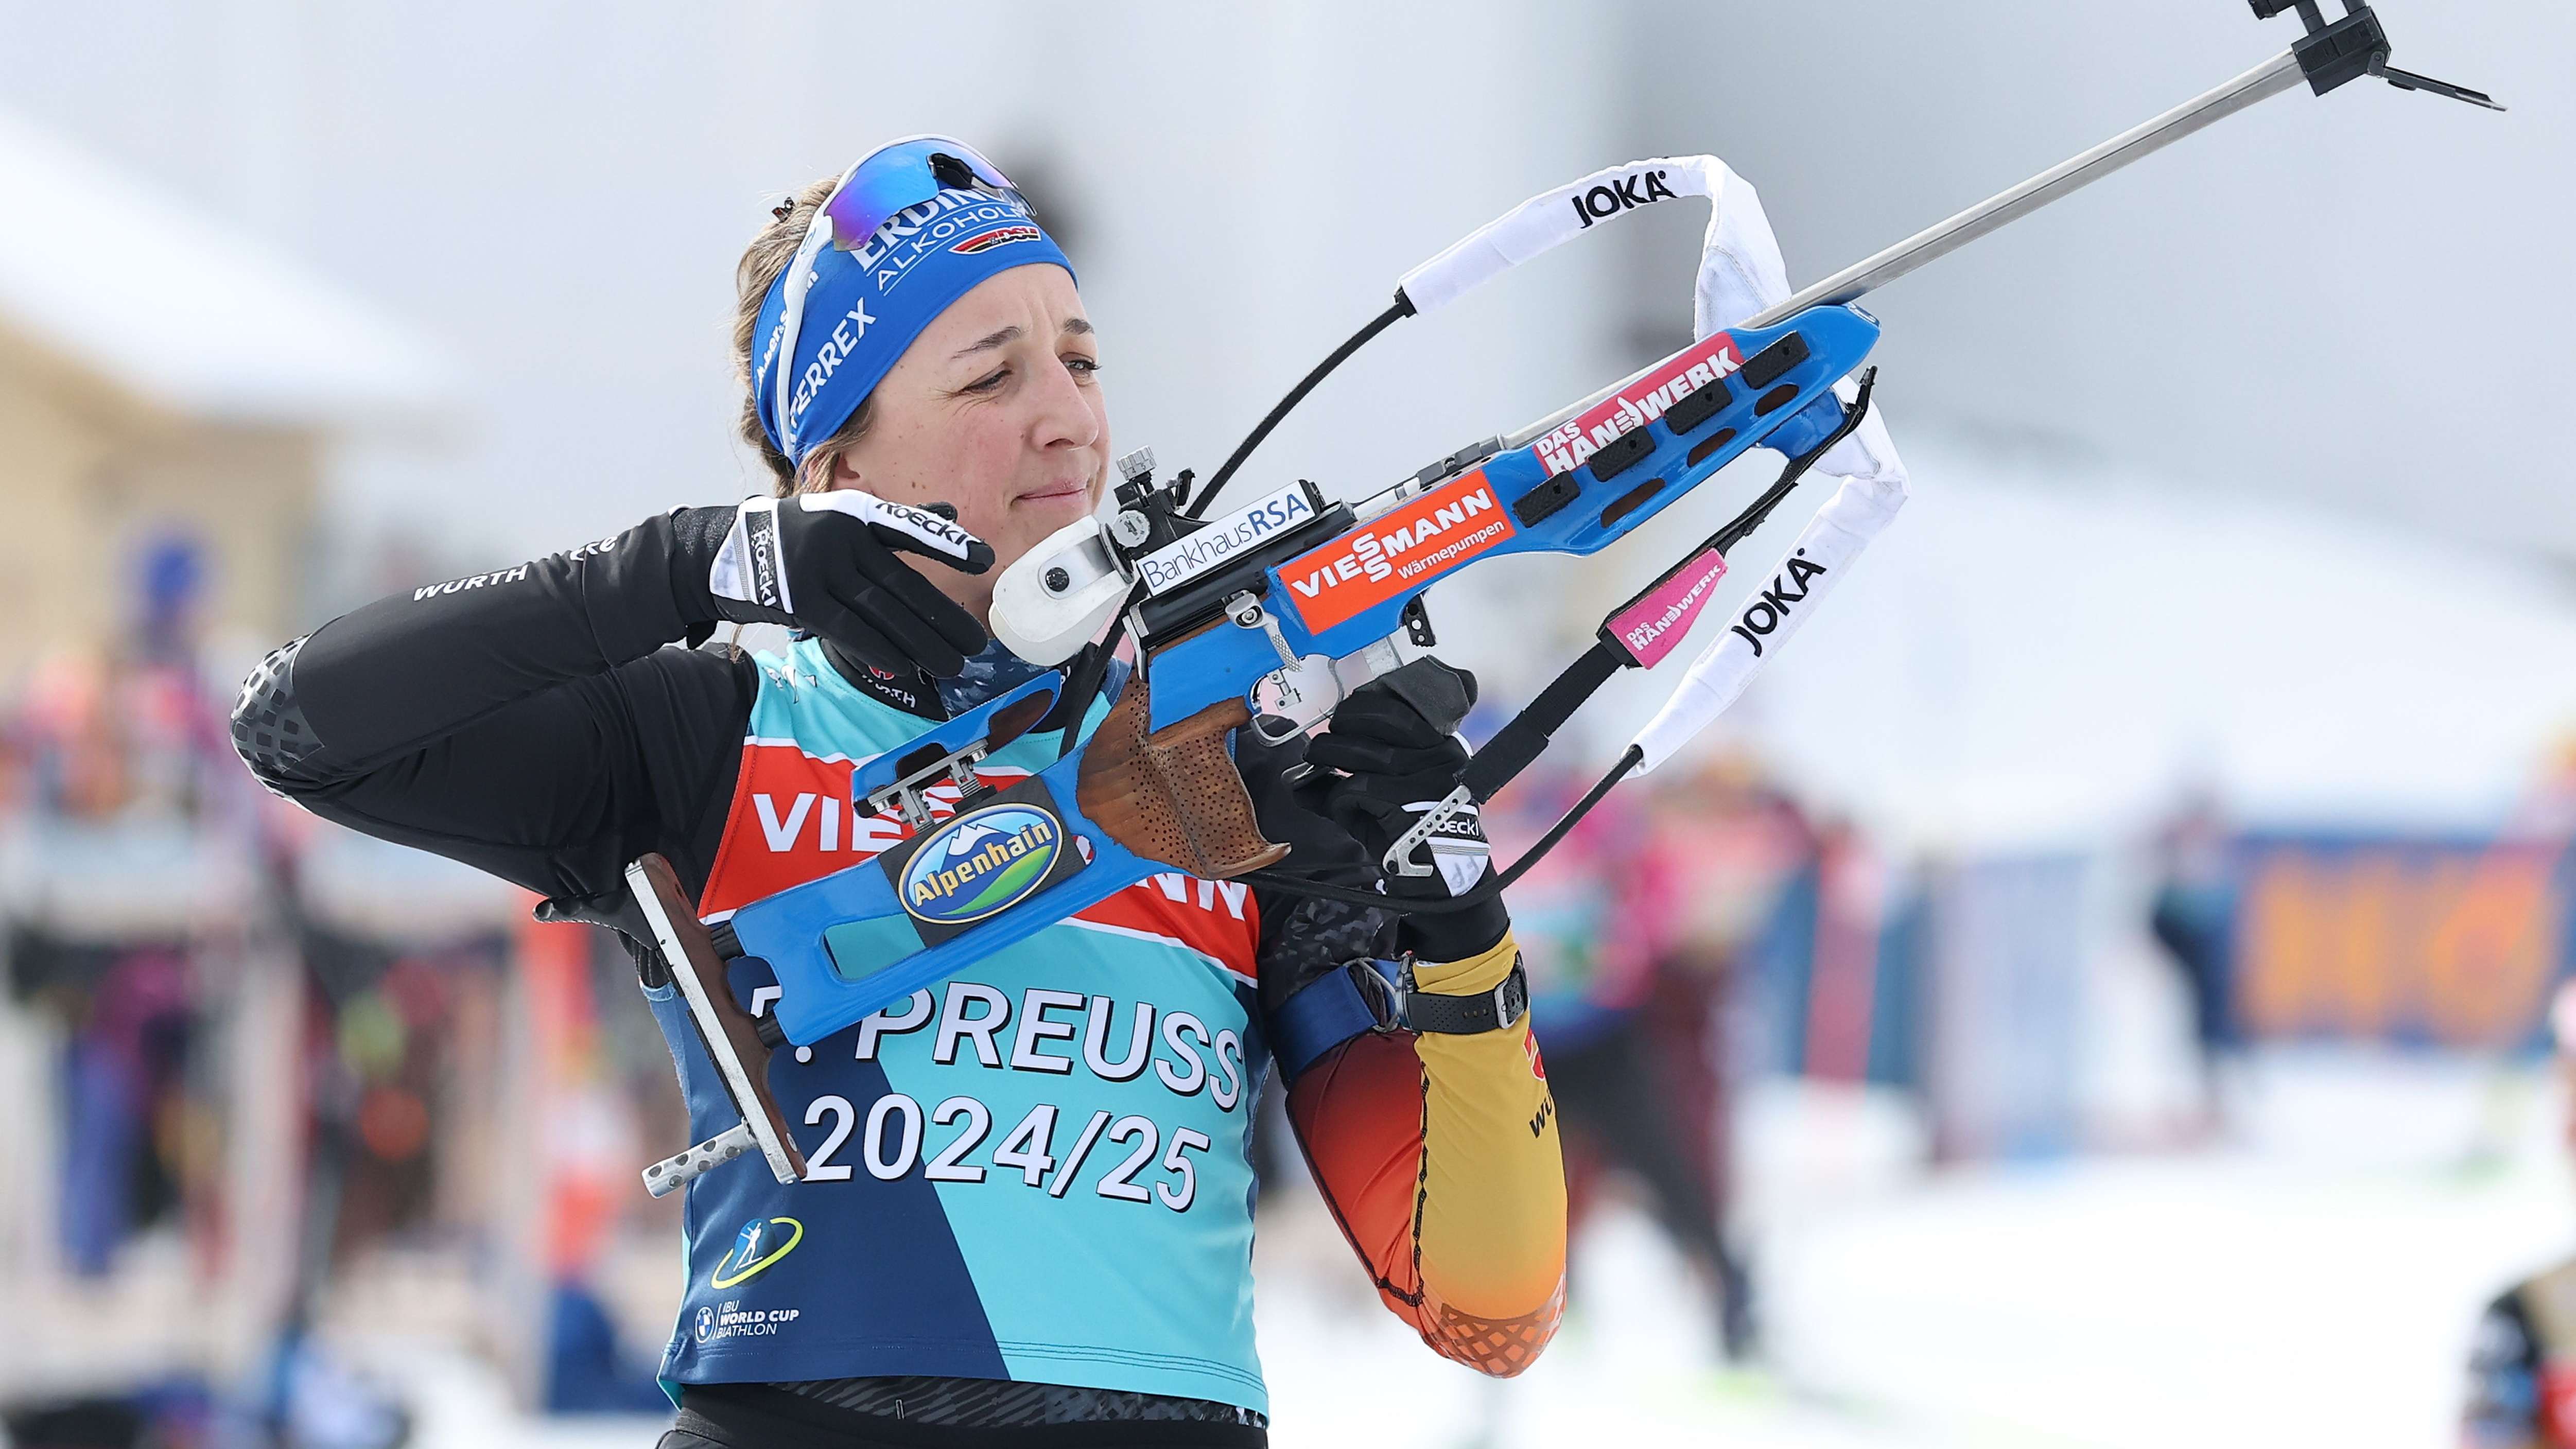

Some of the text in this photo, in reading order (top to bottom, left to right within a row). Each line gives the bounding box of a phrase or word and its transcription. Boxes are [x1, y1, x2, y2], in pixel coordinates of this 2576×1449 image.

[1537, 421, 1582, 456] DAS
[1291, 488, 1492, 598] VIESSMANN
[1397, 520, 1505, 580] Wärmepumpen
[1626, 621, 1650, 642] DAS
[1631, 564, 1721, 652] HANDWERK
[913, 821, 1053, 907] Alpenhain
[855, 981, 1244, 1111] PREUSS
[803, 1094, 1211, 1212] 2024/25
[717, 1323, 777, 1338] BIATHLON
[720, 1312, 766, 1325] WORLD
[769, 1310, 799, 1322] CUP
[722, 1300, 740, 1313] IBU
